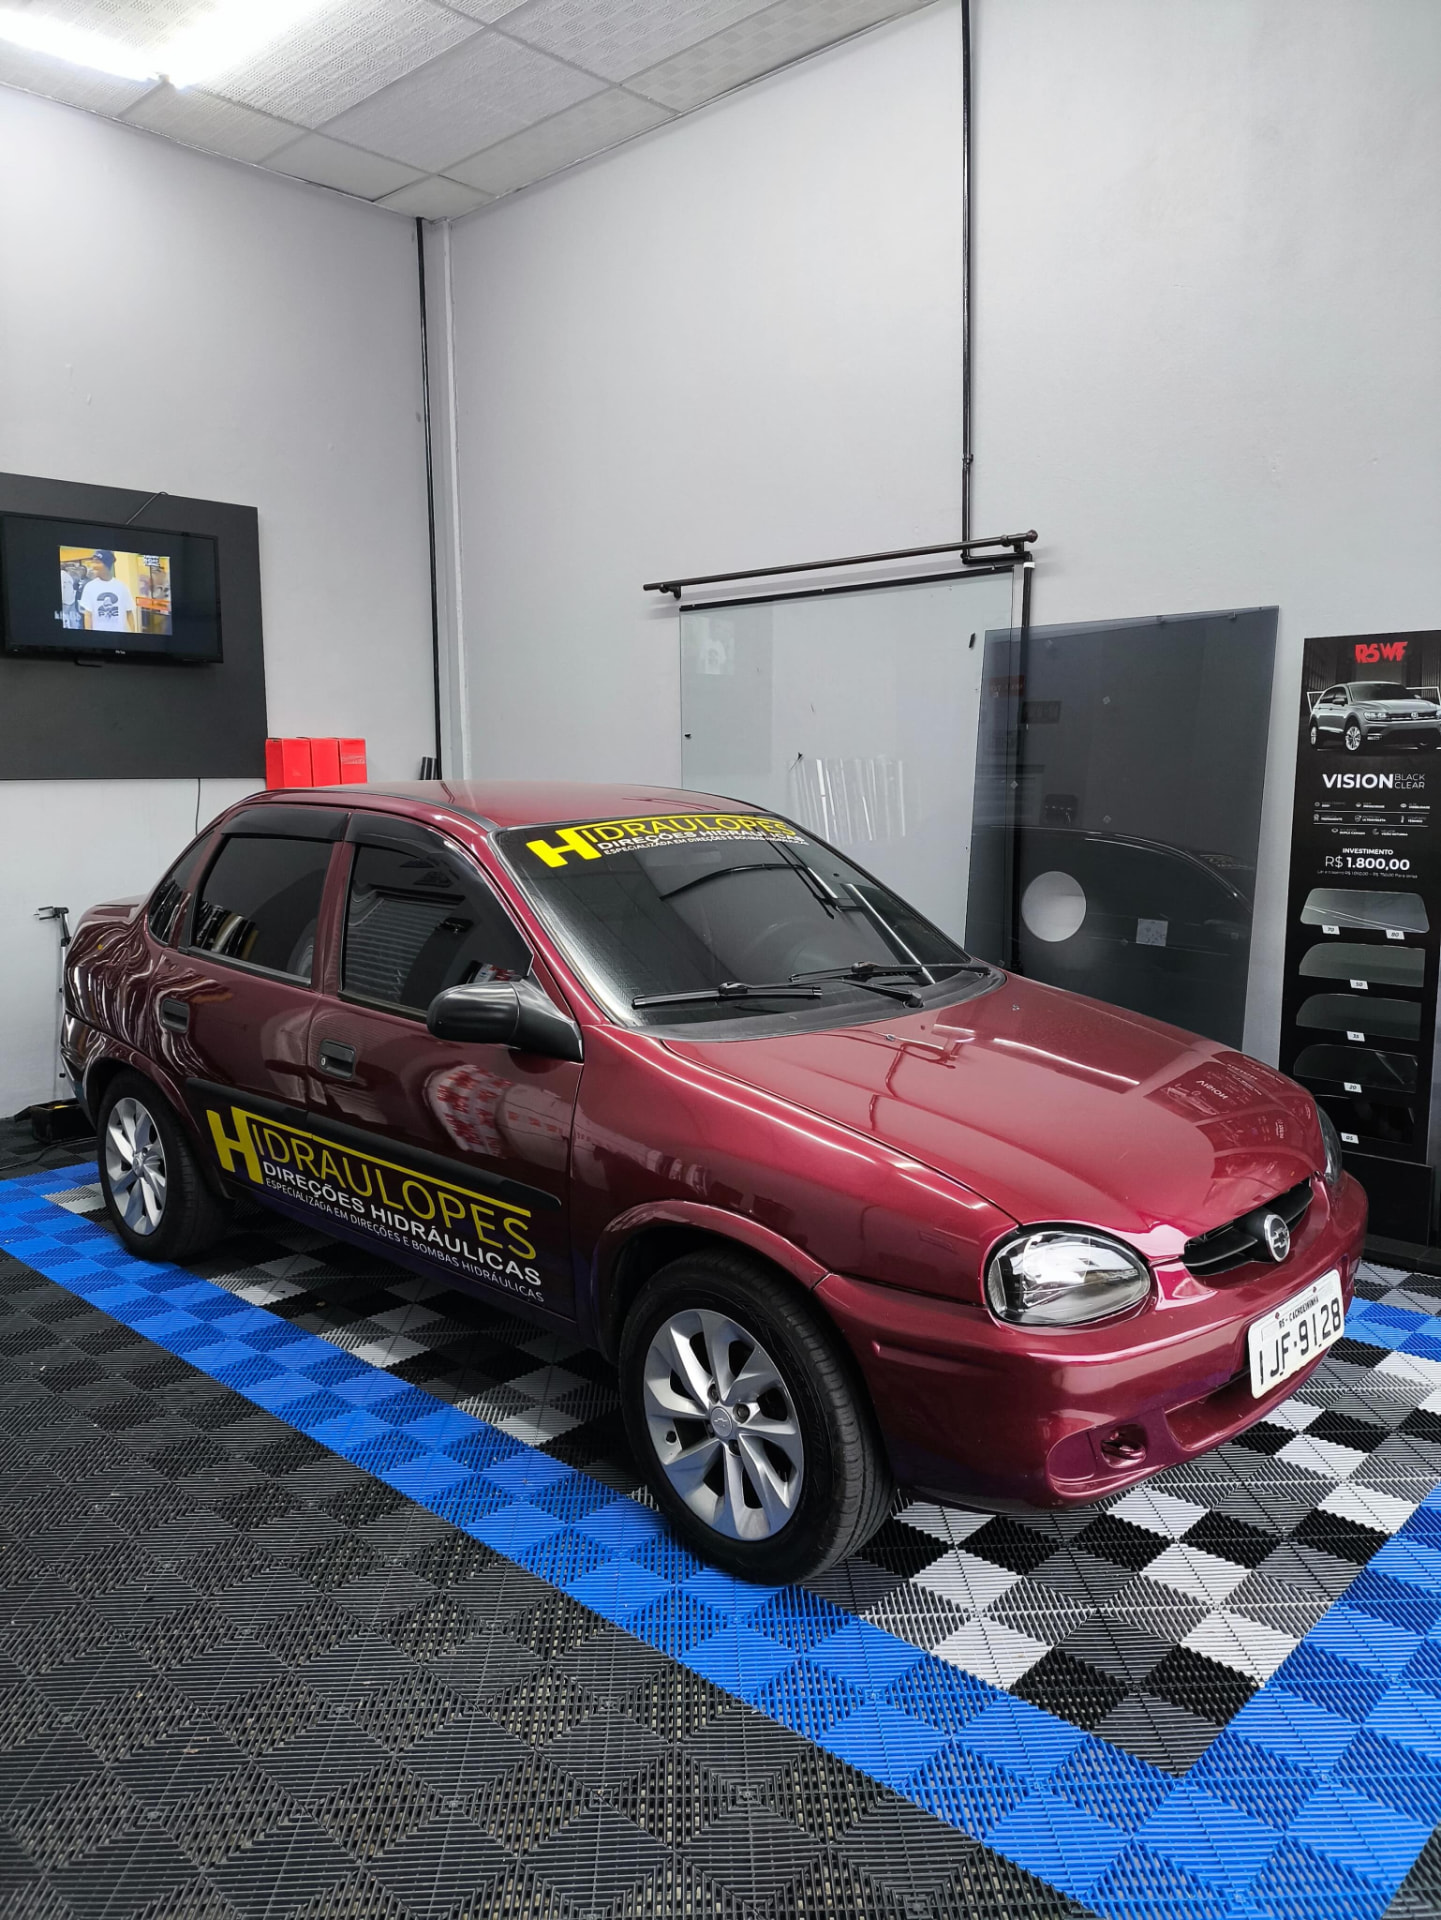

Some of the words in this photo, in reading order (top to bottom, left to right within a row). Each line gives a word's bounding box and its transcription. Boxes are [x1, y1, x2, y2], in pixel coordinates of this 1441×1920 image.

[1322, 773, 1394, 789] VISION
[1394, 773, 1425, 781] BLACK
[1394, 781, 1425, 789] CLEAR
[526, 814, 797, 868] HIDRAULOPES
[597, 831, 697, 850] DIREÇÕES
[603, 840, 674, 855] ESPECIALIZADA
[1342, 847, 1394, 855] INVESTIMENTO
[1325, 855, 1343, 868] R$
[1346, 856, 1410, 871] 1.800,00
[206, 1106, 537, 1260] HIDRAULOPES
[262, 1161, 365, 1213] DIREÇÕES
[370, 1204, 542, 1286] HIDRÁULICAS
[265, 1177, 333, 1215] ESPECIALIZADA
[333, 1207, 349, 1220] EM
[350, 1214, 401, 1242] DIREÇÕES
[402, 1235, 410, 1247] E
[411, 1239, 459, 1267] BOMBAS
[461, 1260, 545, 1302] HIDRÁULICAS
